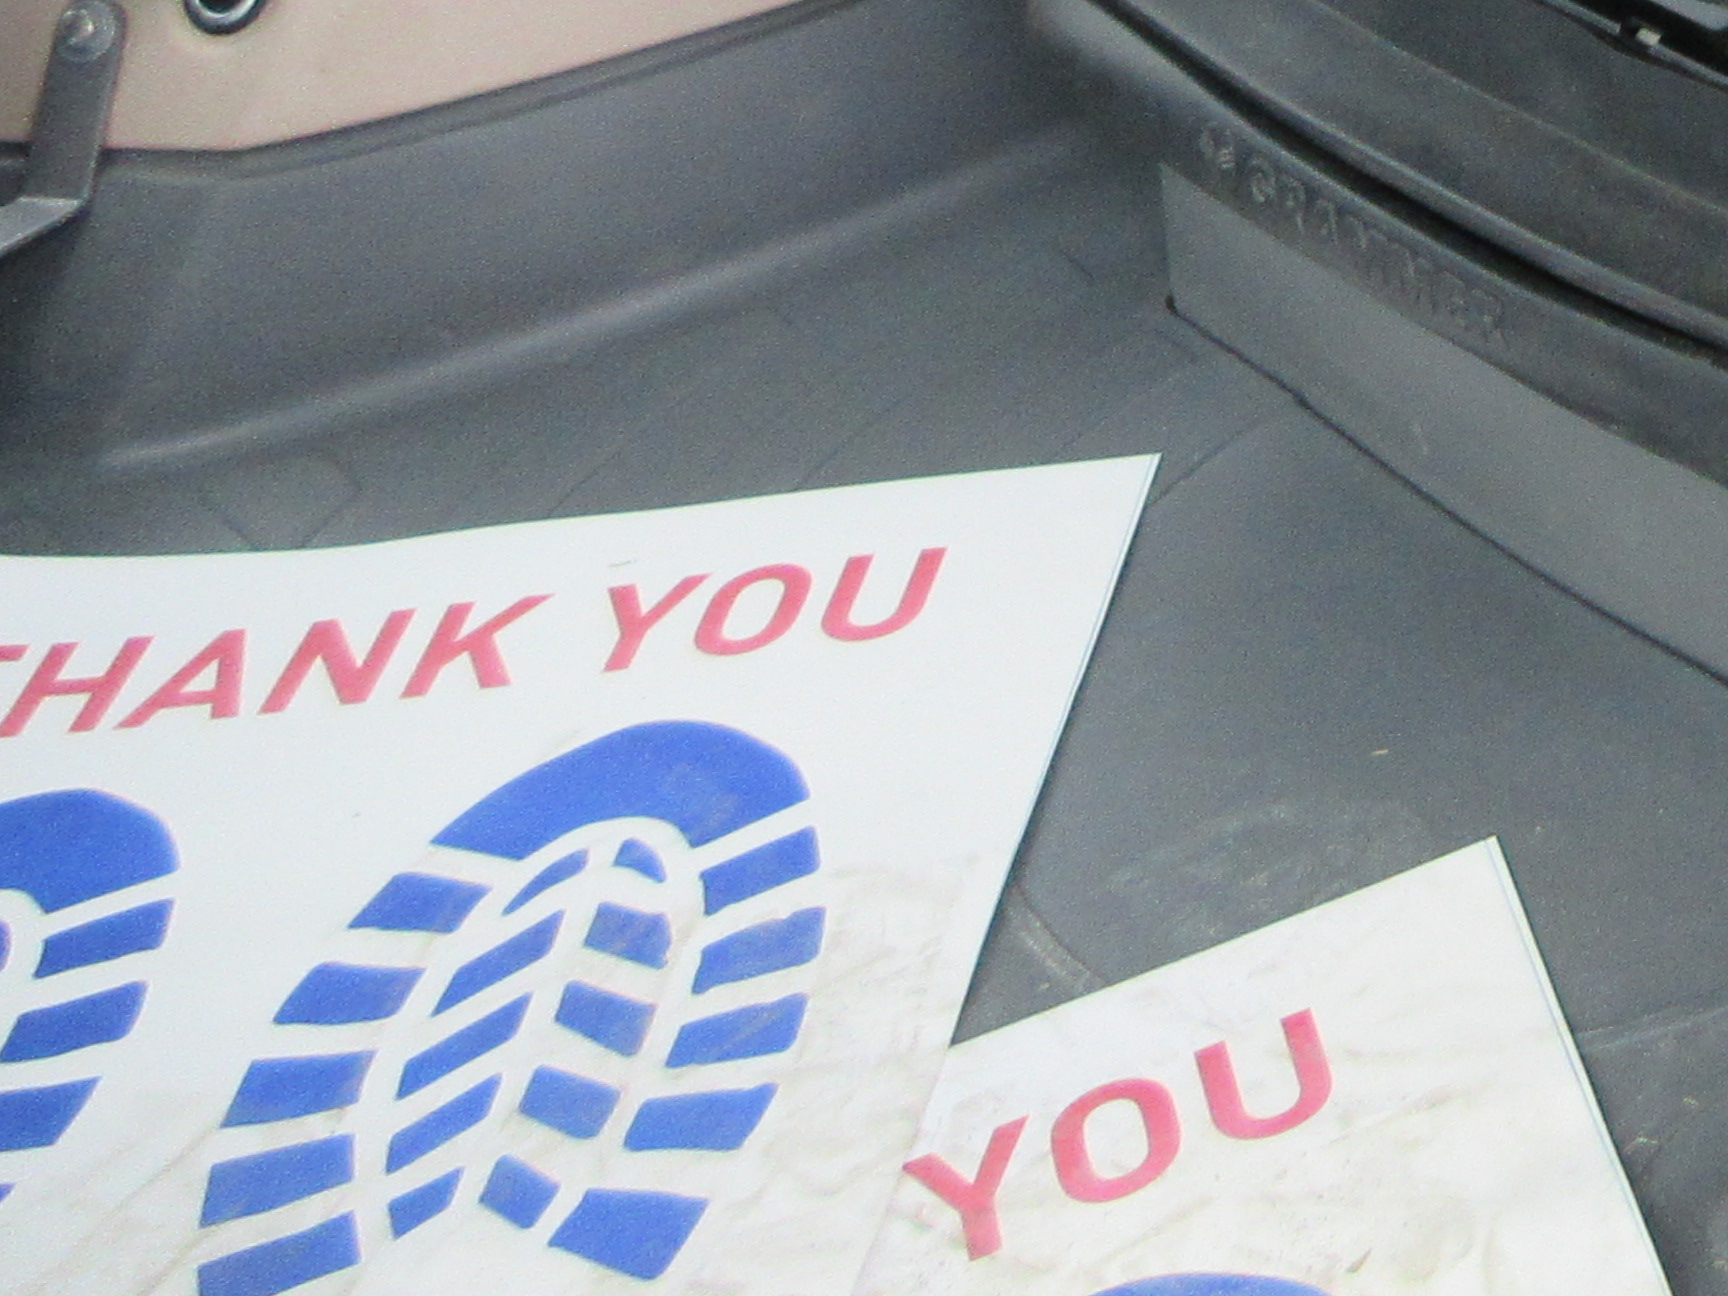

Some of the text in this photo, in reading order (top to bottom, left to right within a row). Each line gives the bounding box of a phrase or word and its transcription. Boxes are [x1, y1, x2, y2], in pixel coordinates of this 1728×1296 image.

[0, 546, 948, 738] HANK YOU
[901, 1007, 1334, 1263] YOU
